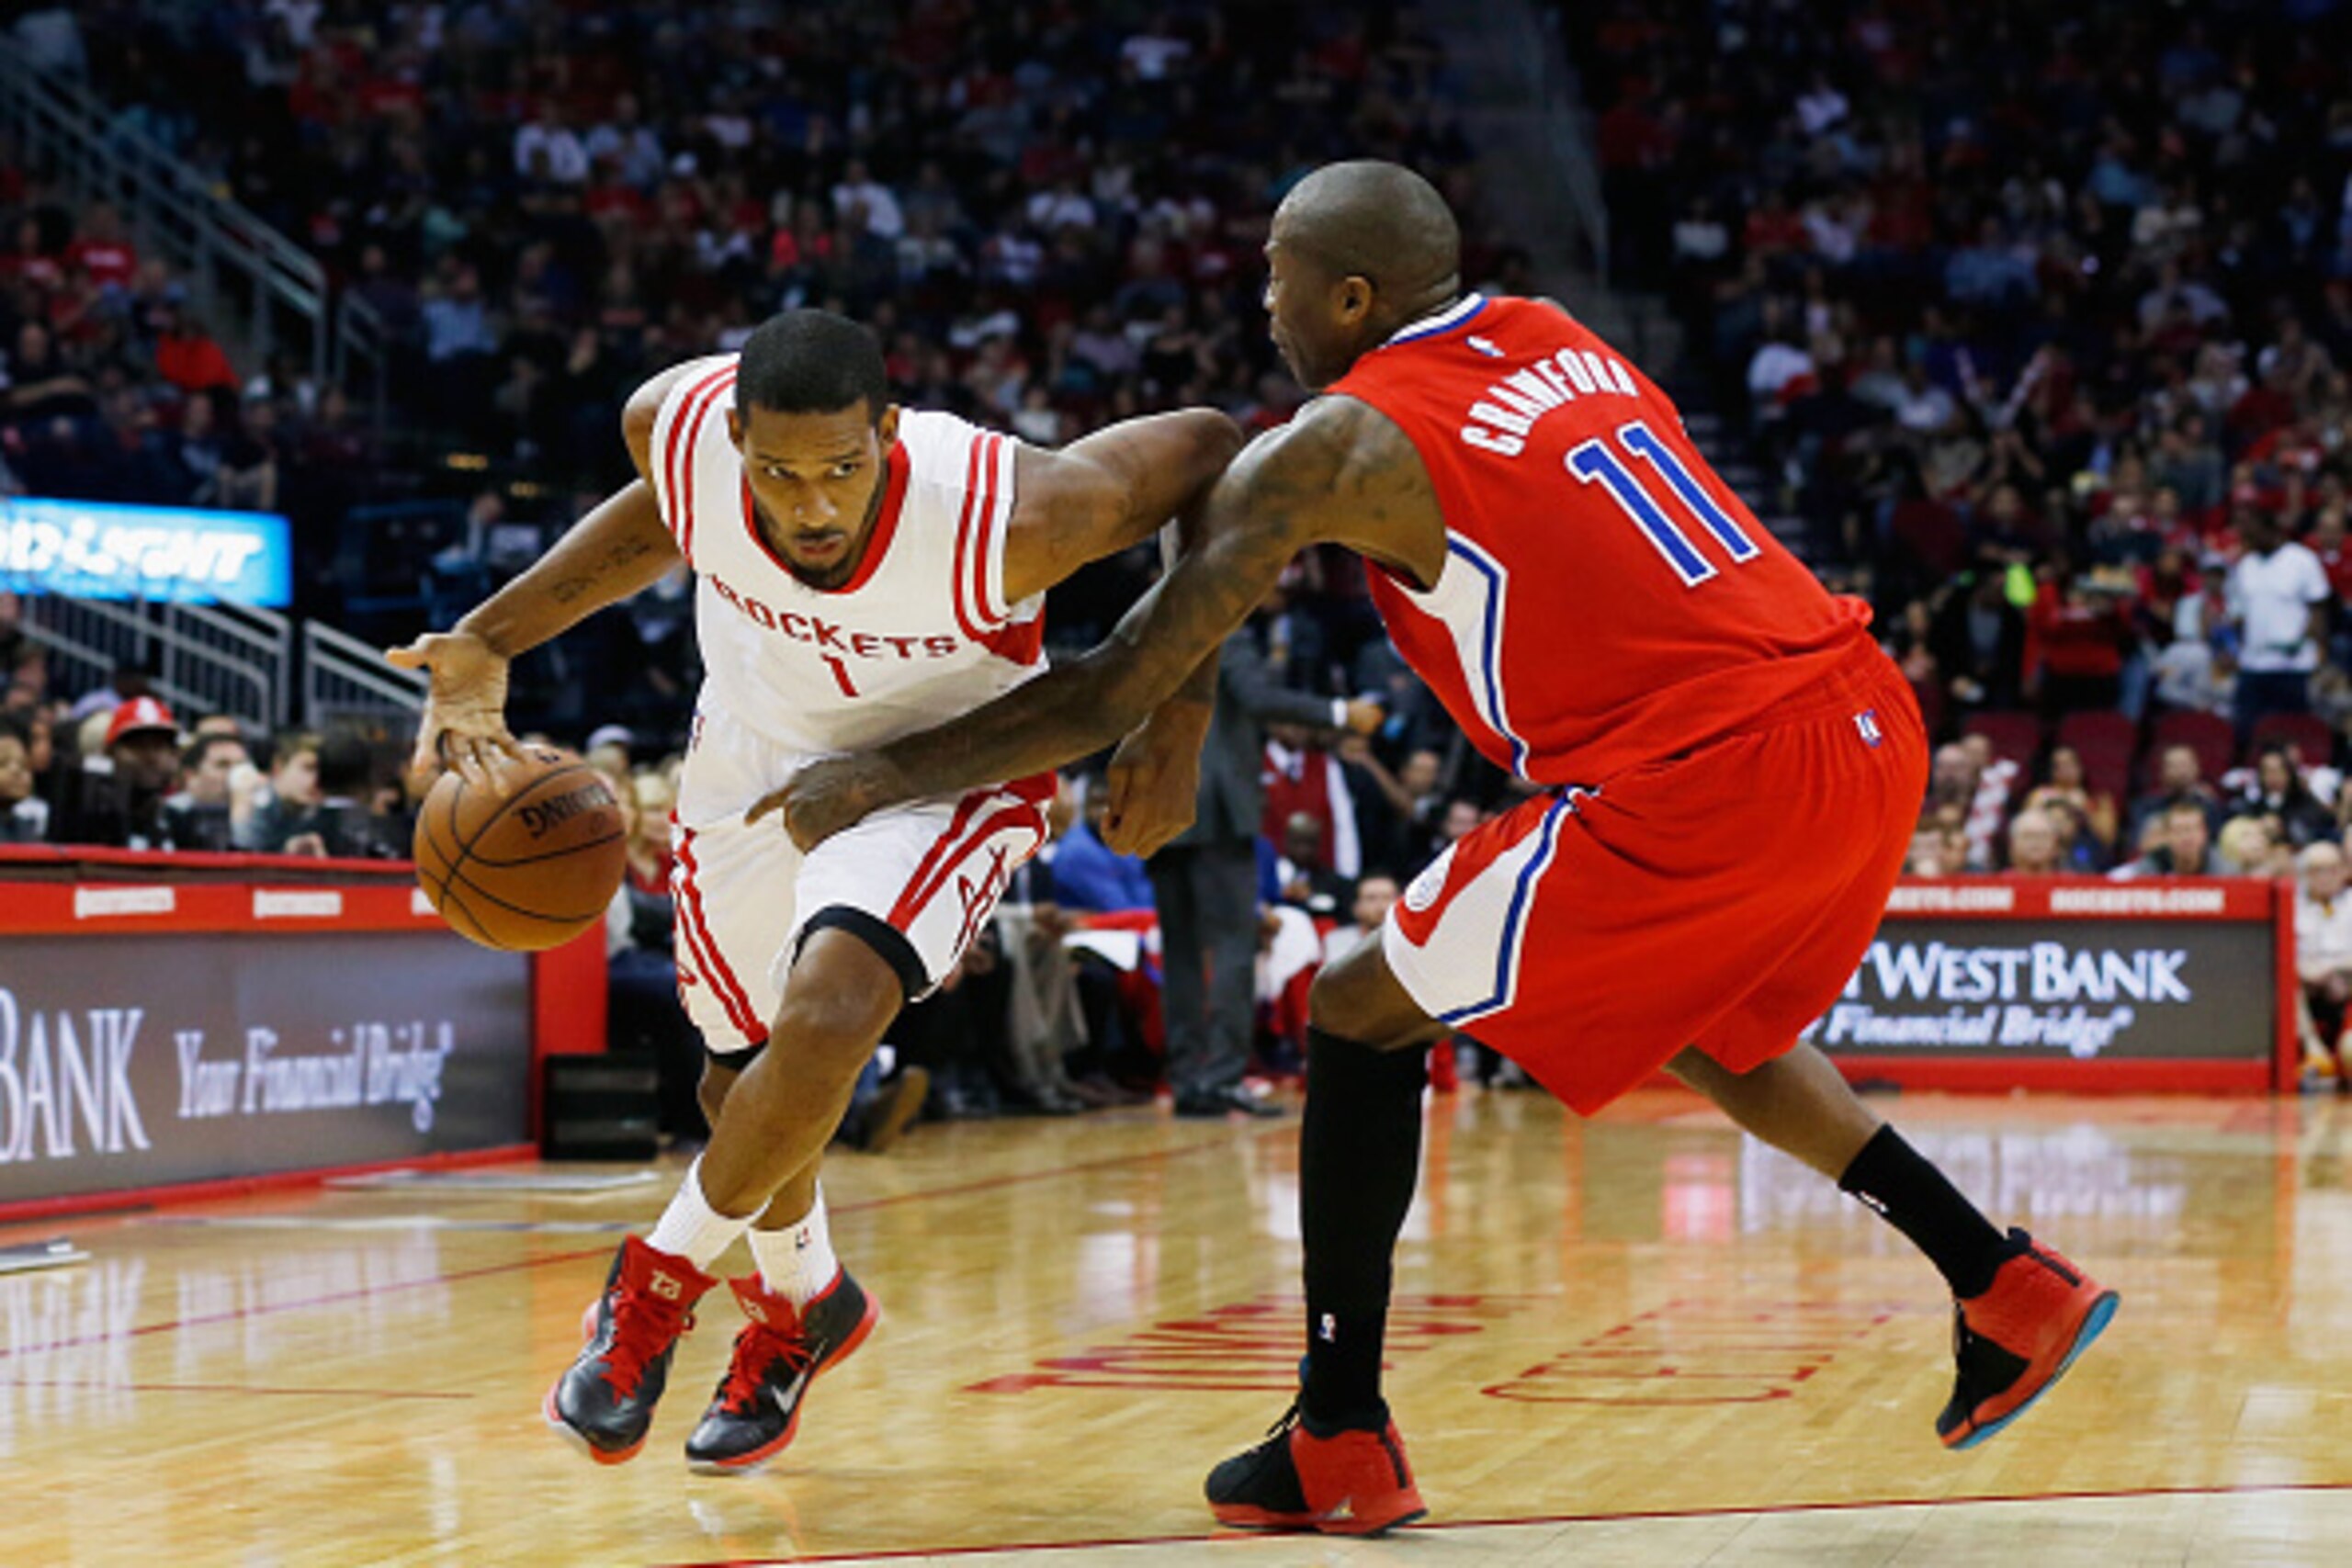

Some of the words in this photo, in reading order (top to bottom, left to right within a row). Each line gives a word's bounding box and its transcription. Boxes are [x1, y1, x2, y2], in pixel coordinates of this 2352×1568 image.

[1566, 420, 1761, 587] 11
[705, 574, 959, 660] ROCKETS
[820, 652, 861, 698] 1
